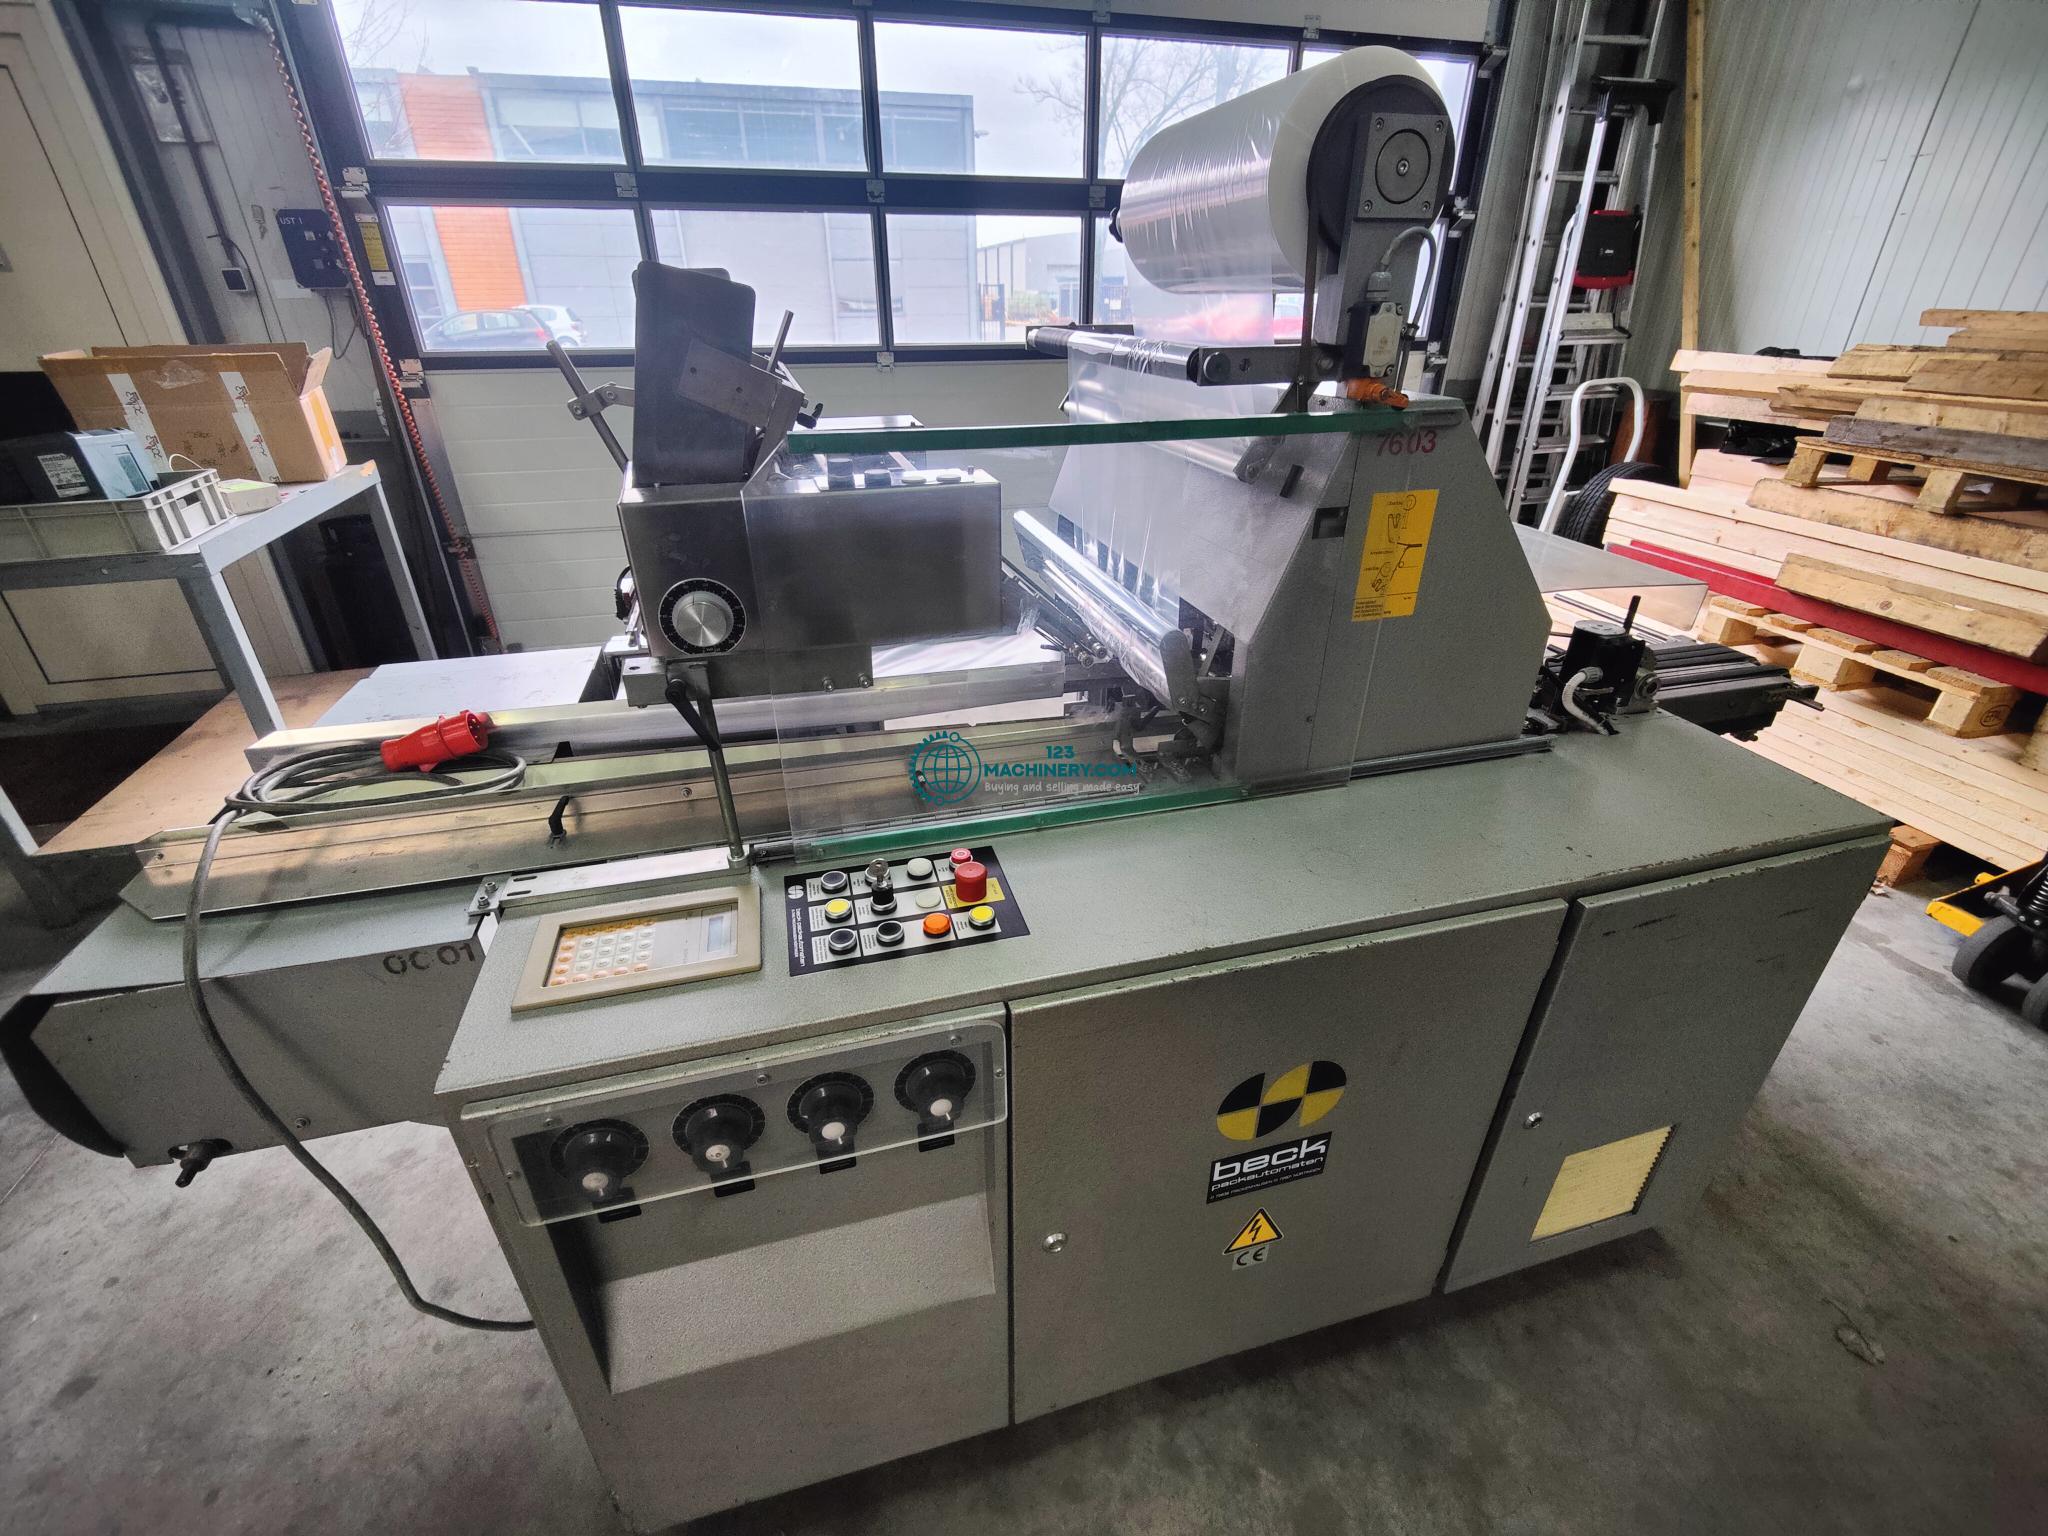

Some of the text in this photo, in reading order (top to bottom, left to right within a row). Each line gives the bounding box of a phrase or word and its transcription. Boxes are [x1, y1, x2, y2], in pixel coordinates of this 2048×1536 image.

[279, 216, 296, 225] UST
[1376, 430, 1437, 456] 7603
[1211, 1156, 1324, 1192] packautomaten
[1212, 1139, 1329, 1182] beck
